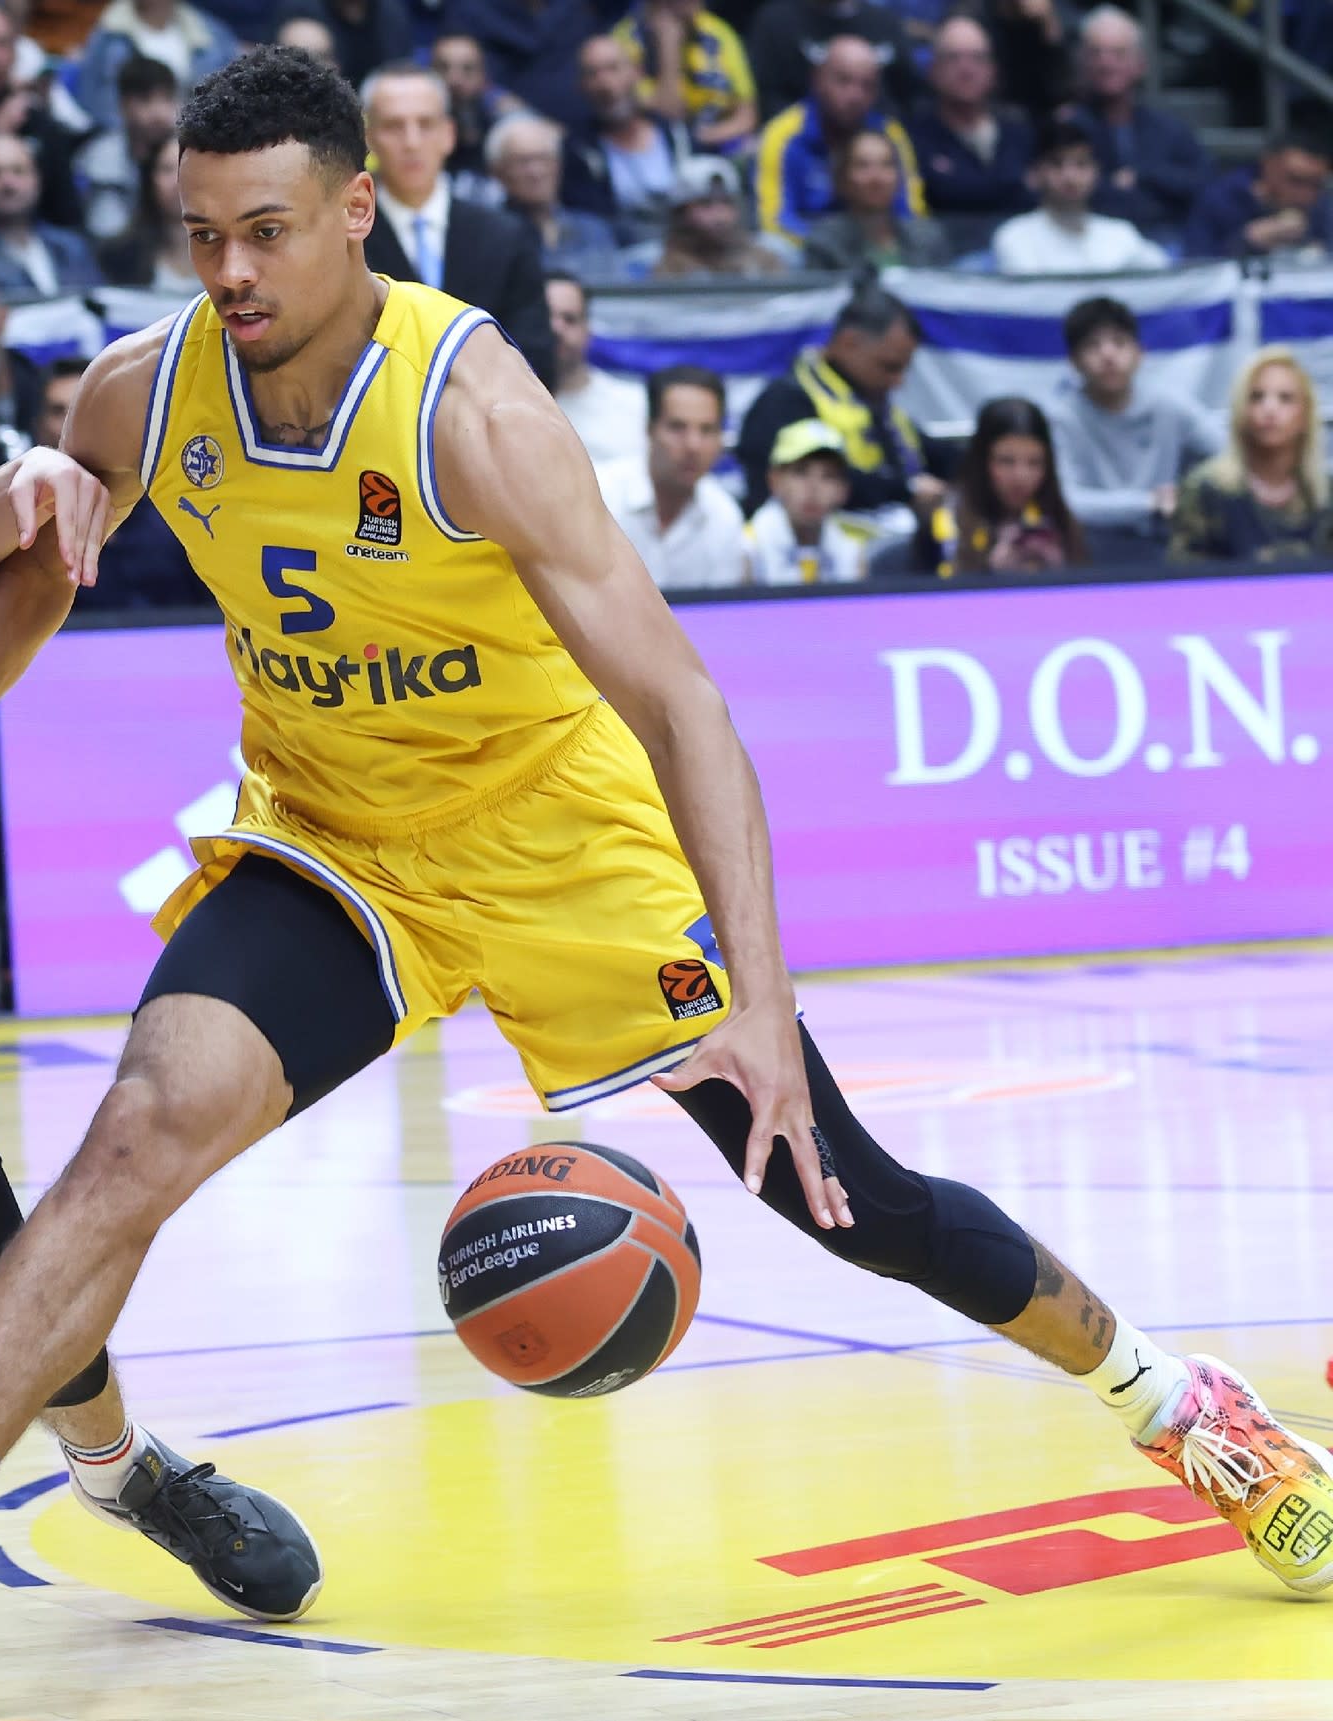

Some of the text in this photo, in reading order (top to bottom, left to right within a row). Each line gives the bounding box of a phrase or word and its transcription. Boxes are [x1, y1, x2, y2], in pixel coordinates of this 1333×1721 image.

[359, 530, 397, 543] EuroLeague
[362, 523, 397, 536] AIRLINES
[364, 515, 397, 528] TURKISH
[261, 545, 336, 635] 5
[232, 627, 482, 708] laytika
[878, 629, 1321, 786] D.O.N.
[975, 823, 1252, 899] ISSUE #4
[675, 993, 716, 1014] TURKISH
[678, 1000, 718, 1019] AIRLINES
[448, 1214, 577, 1269] TURKISH AIRLINES
[450, 1241, 540, 1288] EuroLeague
[1263, 1494, 1312, 1552] PIKE
